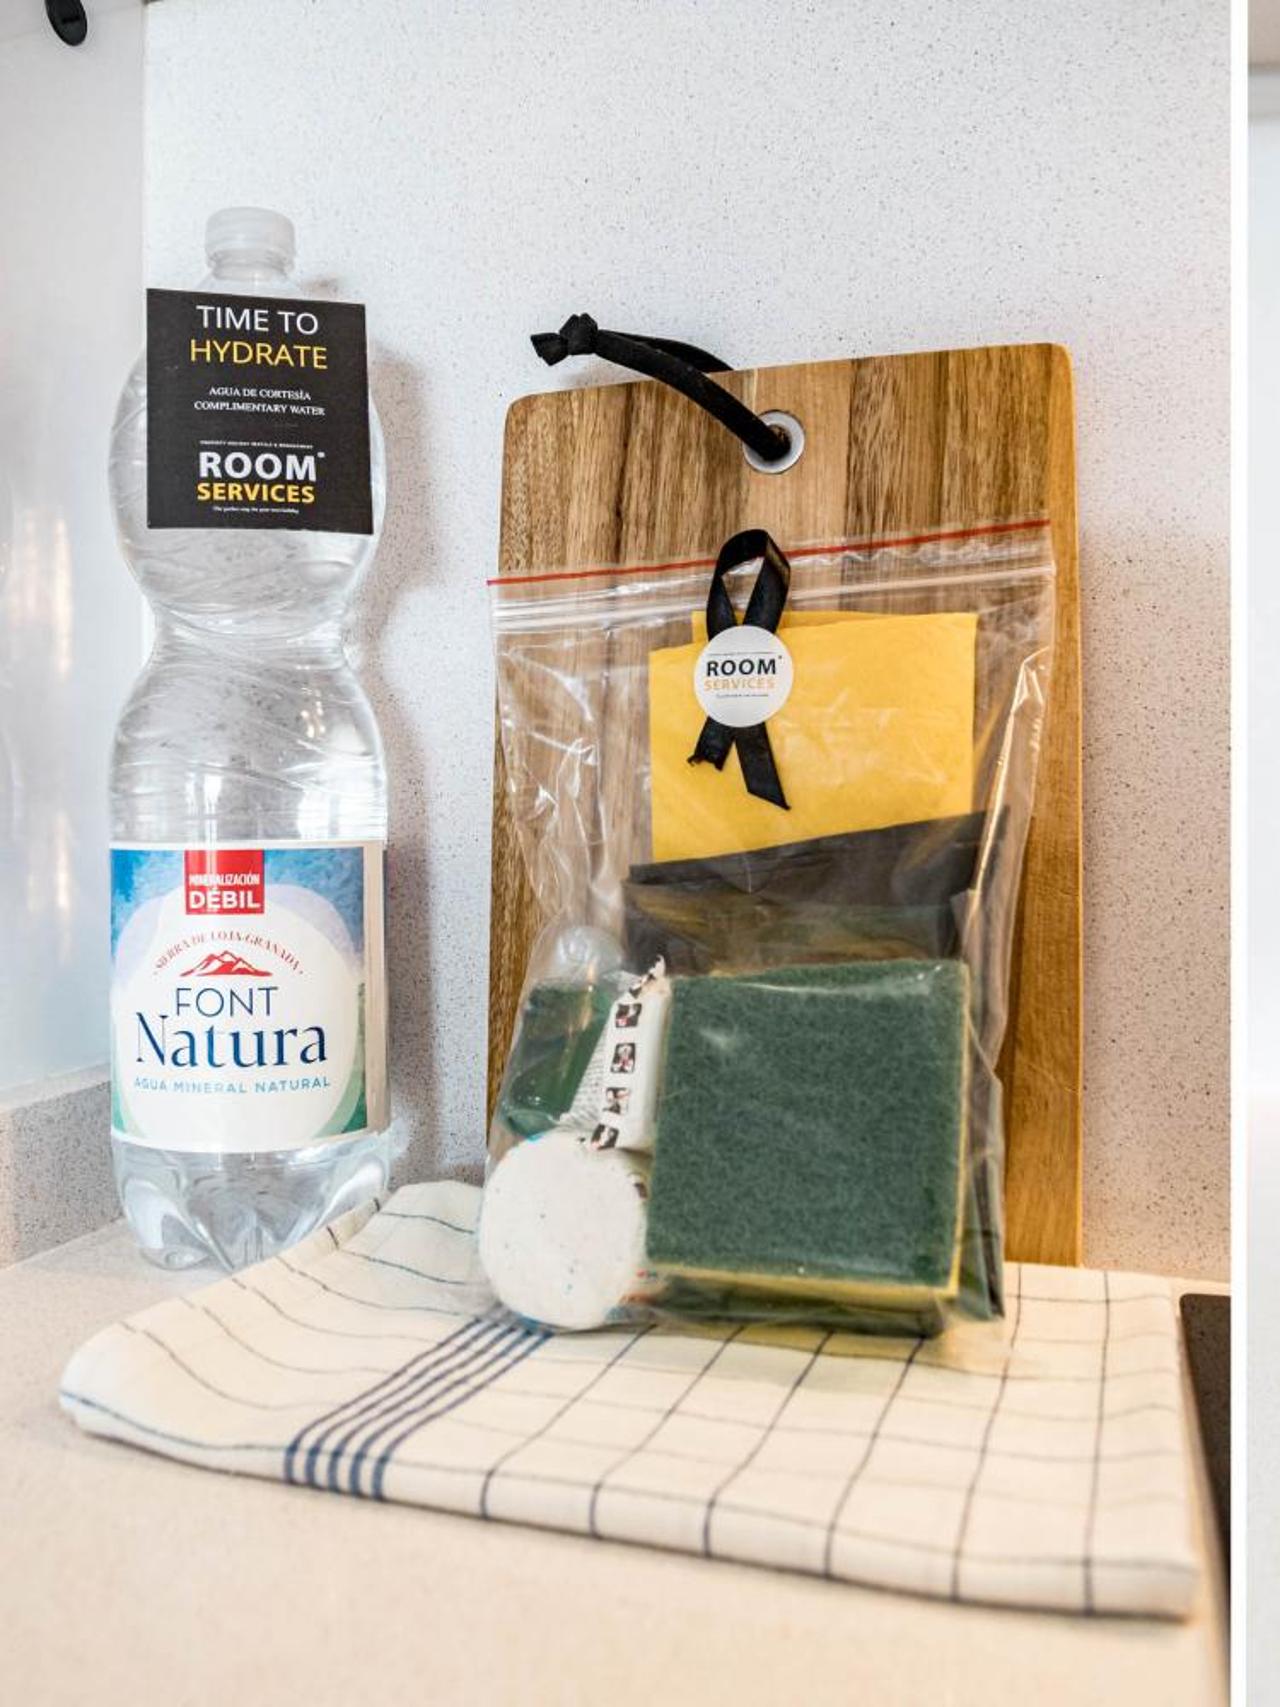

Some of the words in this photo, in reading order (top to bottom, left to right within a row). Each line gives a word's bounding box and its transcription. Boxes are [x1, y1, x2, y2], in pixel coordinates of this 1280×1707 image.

[196, 305, 270, 332] TIME
[277, 310, 319, 336] TO
[190, 338, 328, 370] HYDRATE
[209, 386, 241, 397] AGUA
[242, 387, 258, 398] DE
[259, 388, 312, 401] CORTESÍA
[193, 400, 288, 414] COMPLIMENTARY
[289, 404, 326, 416] WATER
[199, 451, 317, 482] ROOM
[197, 482, 315, 504] SERVICES
[706, 658, 776, 677] ROOM
[704, 677, 776, 692] SERVICES
[189, 887, 261, 909] DÉBIL
[175, 986, 279, 1018] FONT
[135, 1011, 328, 1068] Natura
[134, 1077, 167, 1091] AGUA
[173, 1080, 248, 1094] MINERAL
[255, 1076, 331, 1094] NATURAL
